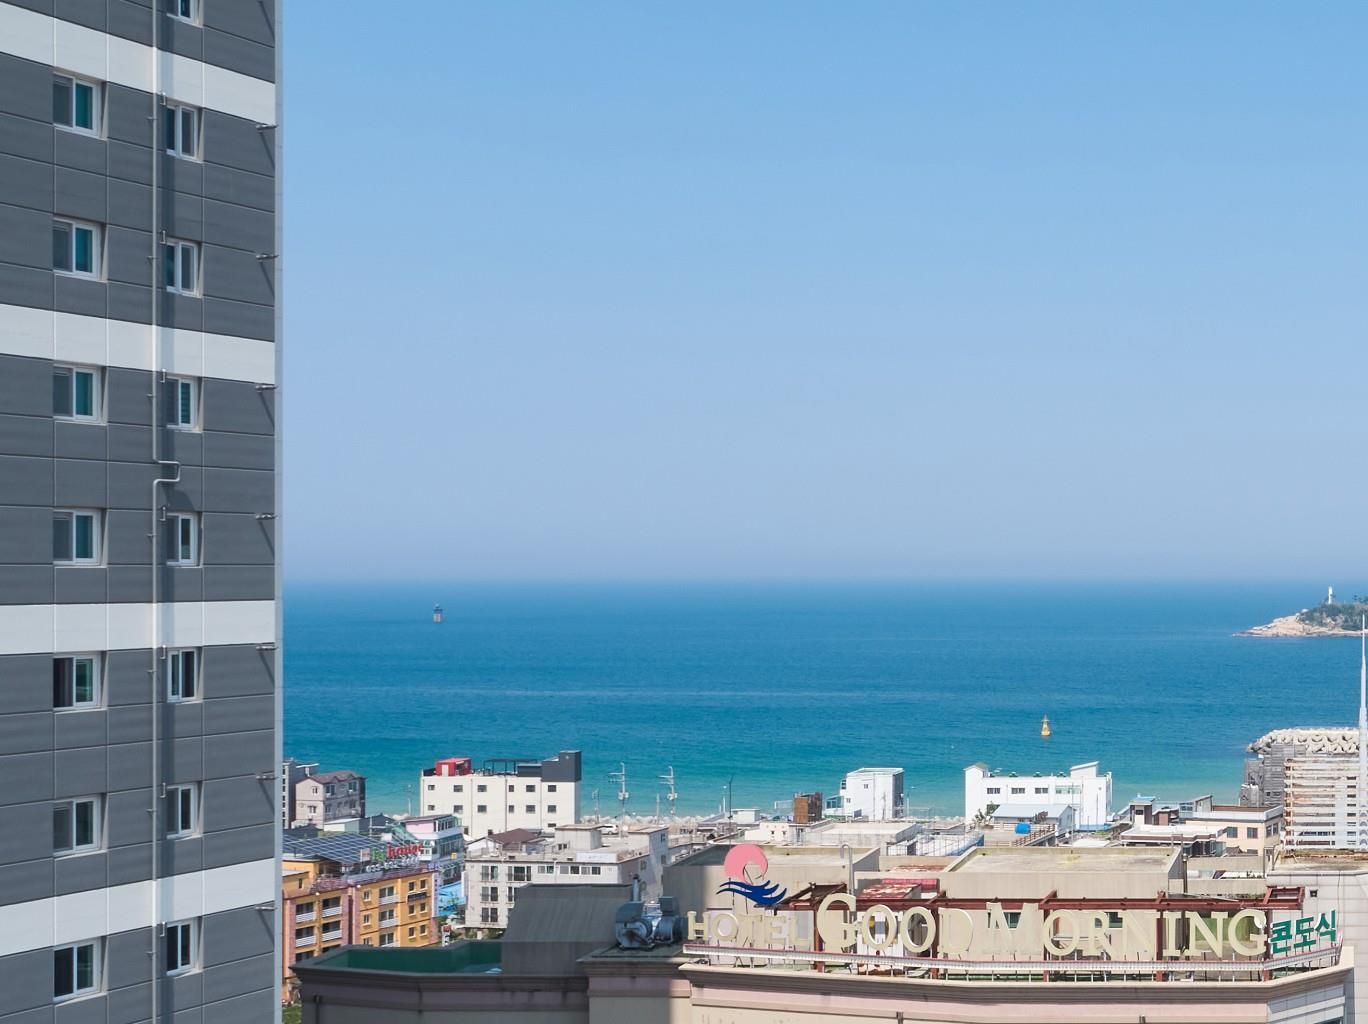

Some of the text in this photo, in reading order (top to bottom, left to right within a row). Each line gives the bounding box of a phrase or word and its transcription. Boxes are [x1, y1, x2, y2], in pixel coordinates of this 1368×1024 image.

[687, 892, 1267, 957] HOTEL GOOD MORNING
[1267, 909, 1337, 954] 콘도식
